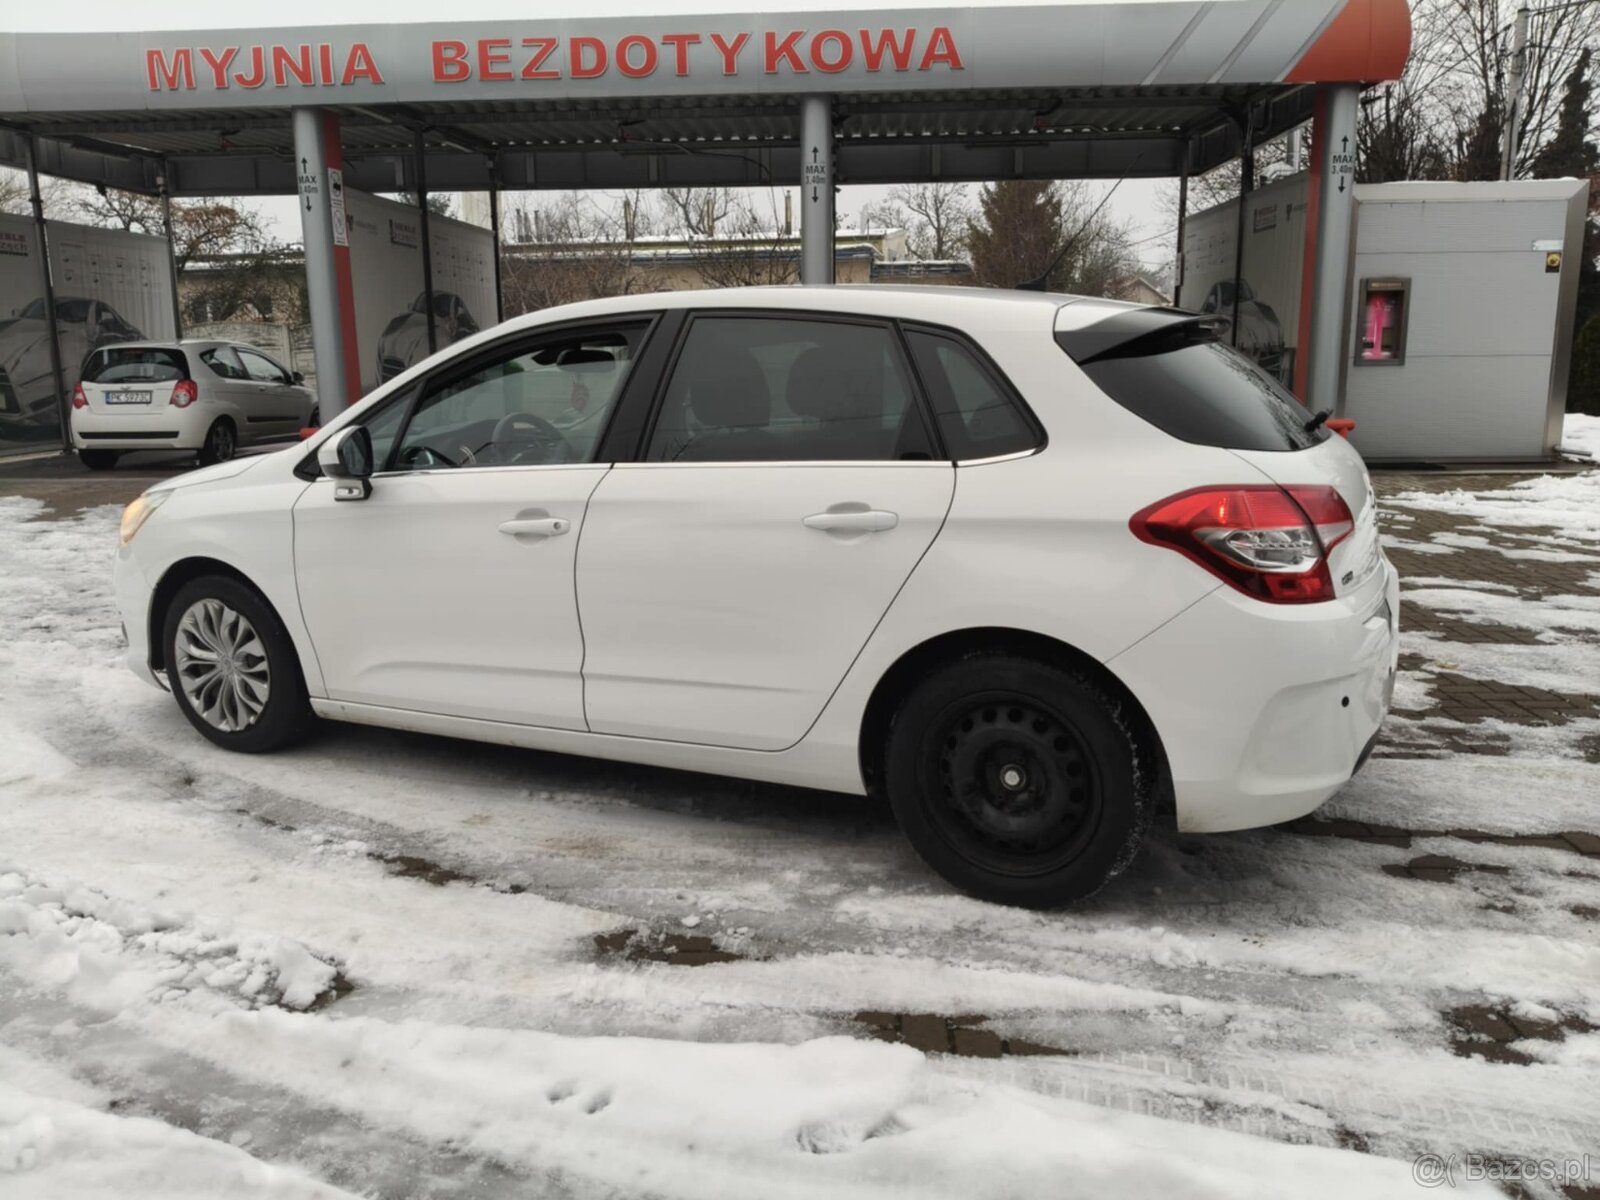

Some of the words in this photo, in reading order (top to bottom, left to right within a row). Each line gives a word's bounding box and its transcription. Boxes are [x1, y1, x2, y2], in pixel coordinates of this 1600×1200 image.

[145, 42, 383, 91] MYJNIA
[431, 26, 963, 83] BEZDOTYKOWA
[1332, 155, 1353, 164] MAX
[805, 165, 825, 174] MAX
[299, 176, 317, 184] MAX
